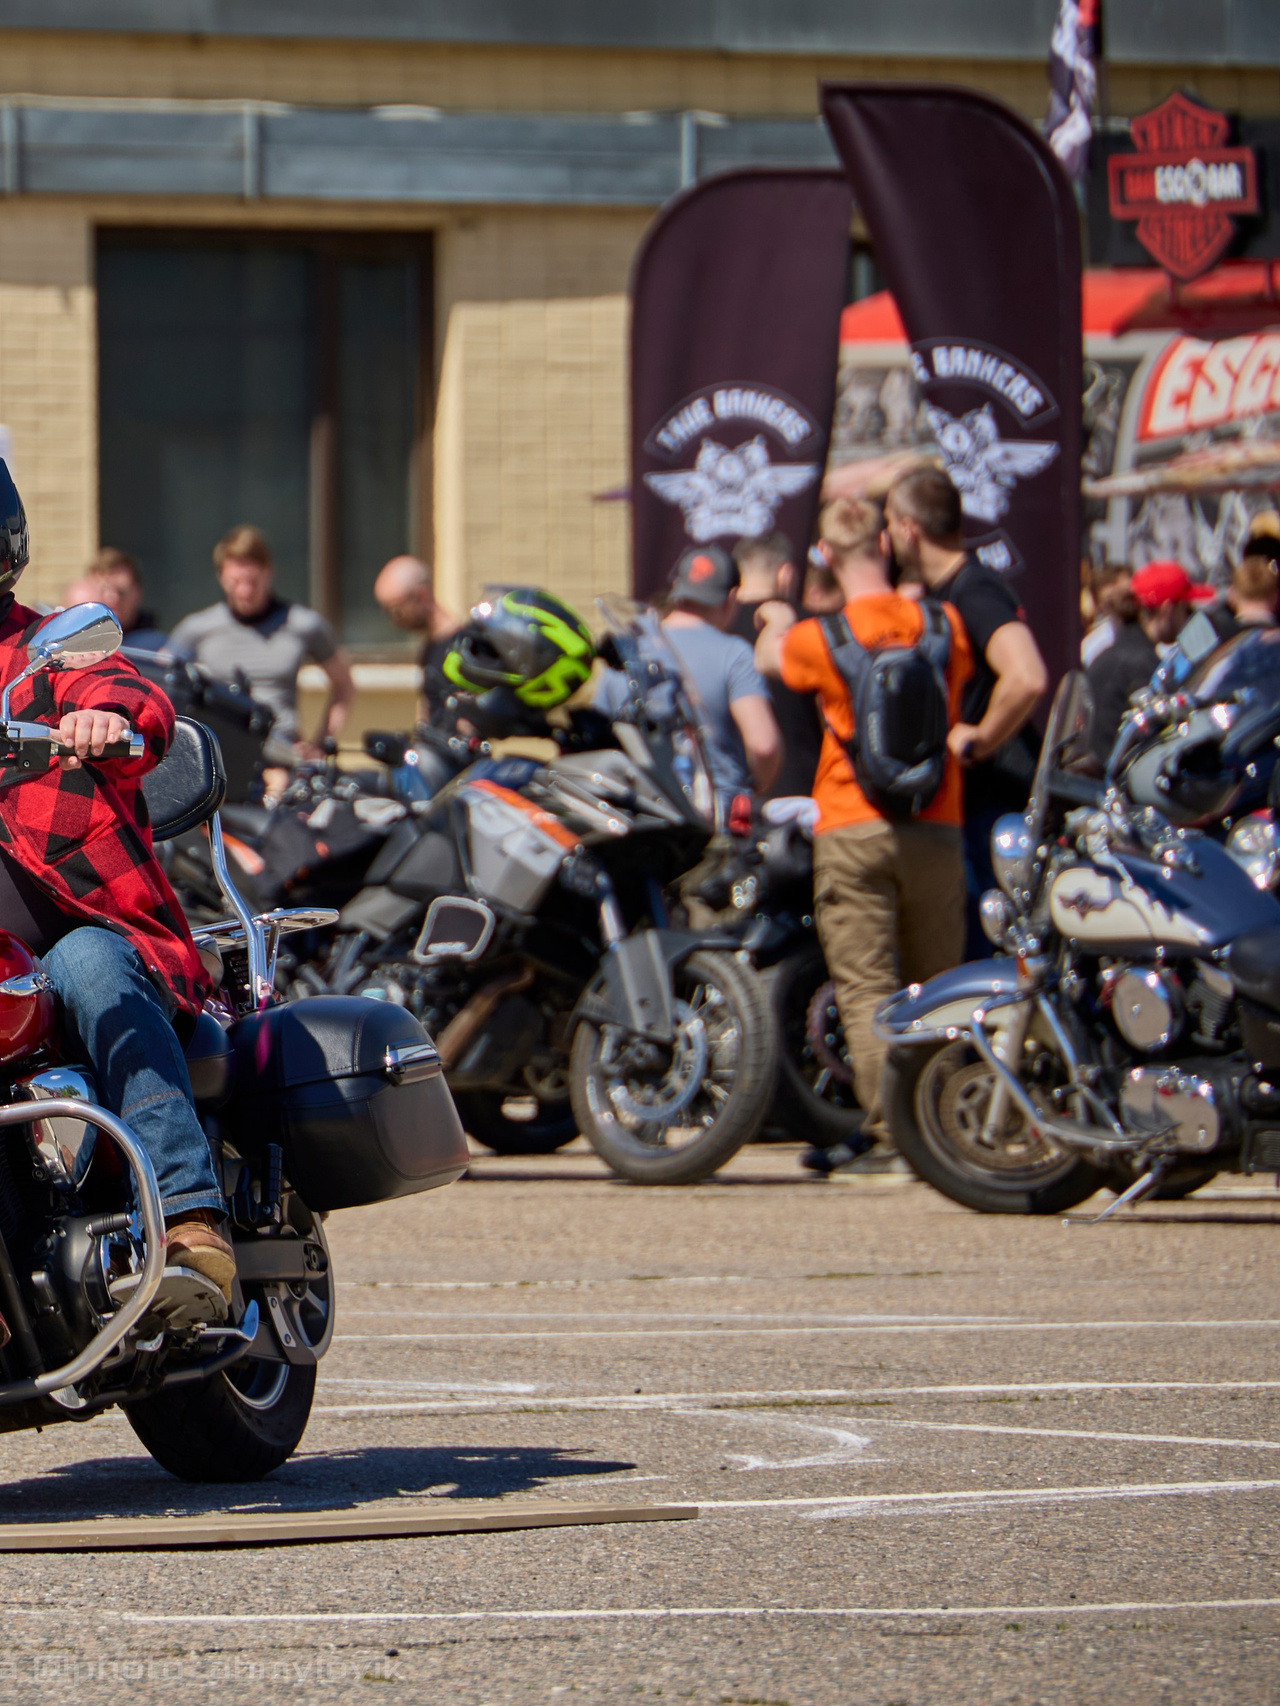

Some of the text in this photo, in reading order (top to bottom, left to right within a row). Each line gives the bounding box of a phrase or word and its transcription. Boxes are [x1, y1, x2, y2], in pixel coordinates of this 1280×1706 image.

[932, 345, 1044, 416] BANKERS
[1148, 333, 1280, 433] ESC
[713, 388, 812, 445] BANKERS
